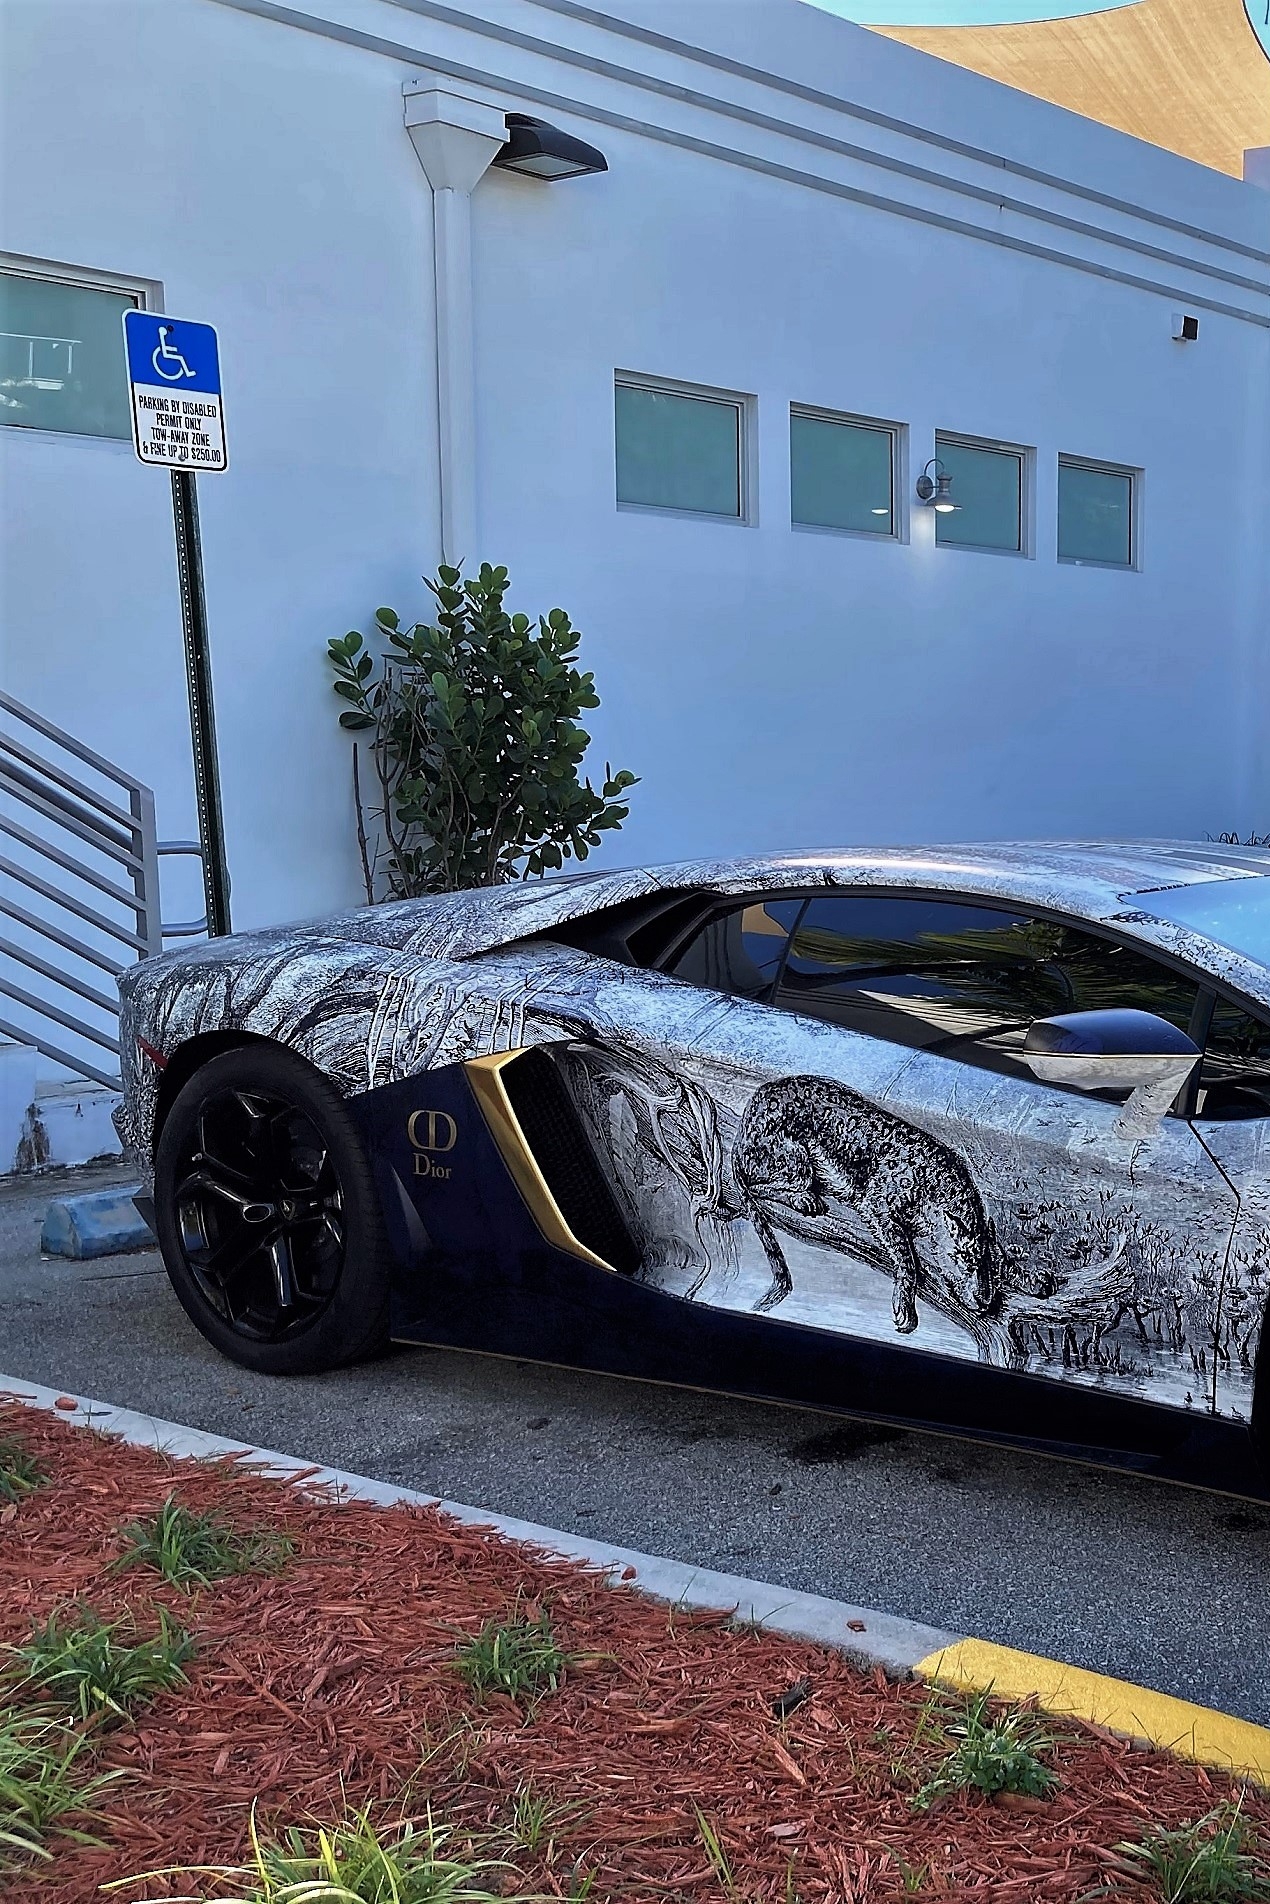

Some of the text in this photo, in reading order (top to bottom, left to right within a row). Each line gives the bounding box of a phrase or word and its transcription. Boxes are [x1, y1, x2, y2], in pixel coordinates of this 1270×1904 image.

[138, 395, 217, 418] PARKING BY DISABLED
[156, 413, 201, 430] PERMIT ONLY
[151, 426, 211, 447] TOW-AWAY ZONE
[143, 441, 221, 463] & FINE UP TO $250.00
[413, 1152, 452, 1179] Dior
